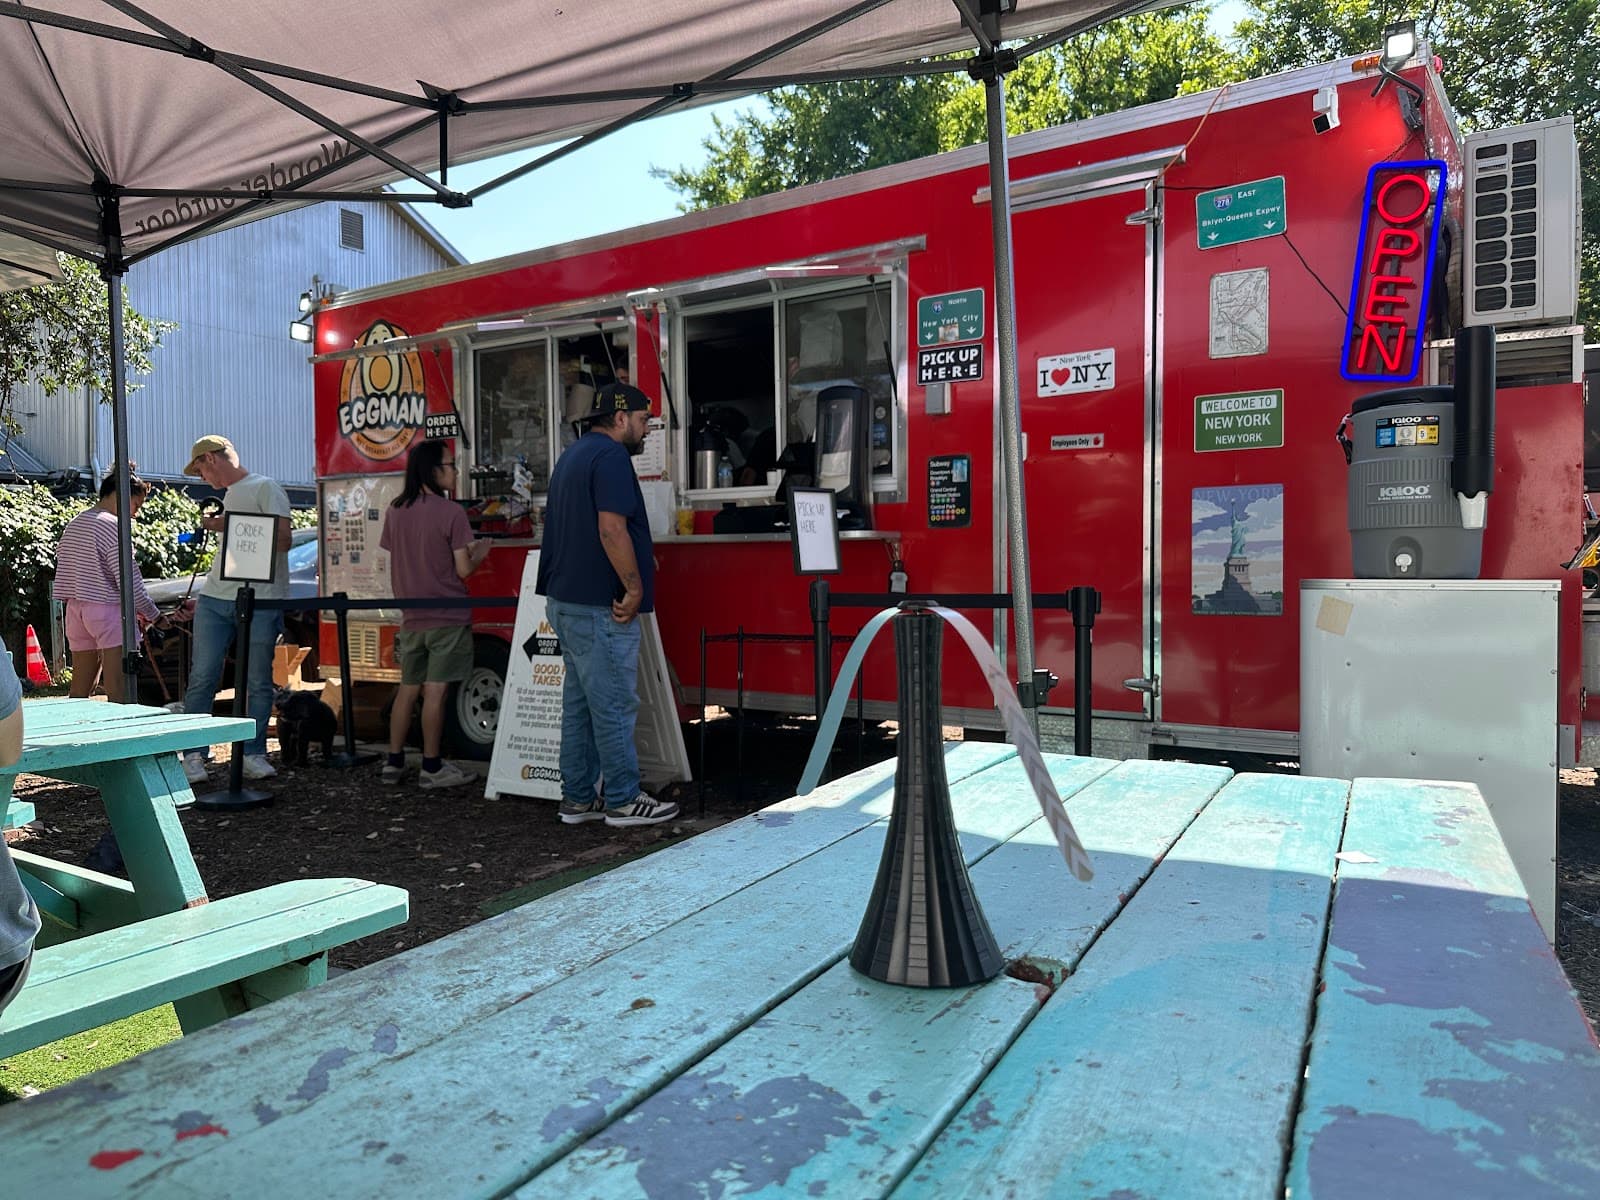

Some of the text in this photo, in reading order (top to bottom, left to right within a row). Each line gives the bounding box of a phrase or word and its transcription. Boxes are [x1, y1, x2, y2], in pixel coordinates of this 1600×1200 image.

[1238, 189, 1256, 199] EAST
[1217, 198, 1230, 208] 278
[1202, 206, 1280, 227] Bklyn-Queens Expwy
[1357, 174, 1430, 370] OPEN
[941, 317, 958, 325] York
[922, 348, 979, 366] PICK UP
[1076, 354, 1091, 362] York
[1040, 370, 1049, 388] I
[1205, 396, 1272, 413] WELCOME TO
[339, 394, 425, 434] EGGMAN
[1391, 416, 1422, 425] IGLOO
[426, 415, 456, 427] ORDER
[1205, 412, 1271, 431] NEW YORK
[1079, 437, 1090, 446] Only
[1215, 431, 1263, 445] NEW YORK
[1194, 487, 1280, 500] NEW YORK
[1380, 485, 1430, 497] IGLOO
[235, 522, 264, 537] ORDER
[236, 540, 257, 553] HERE
[537, 639, 558, 648] ORDER
[534, 663, 560, 675] GOOD
[532, 675, 562, 686] TAKES
[528, 767, 561, 782] EGGMAN
